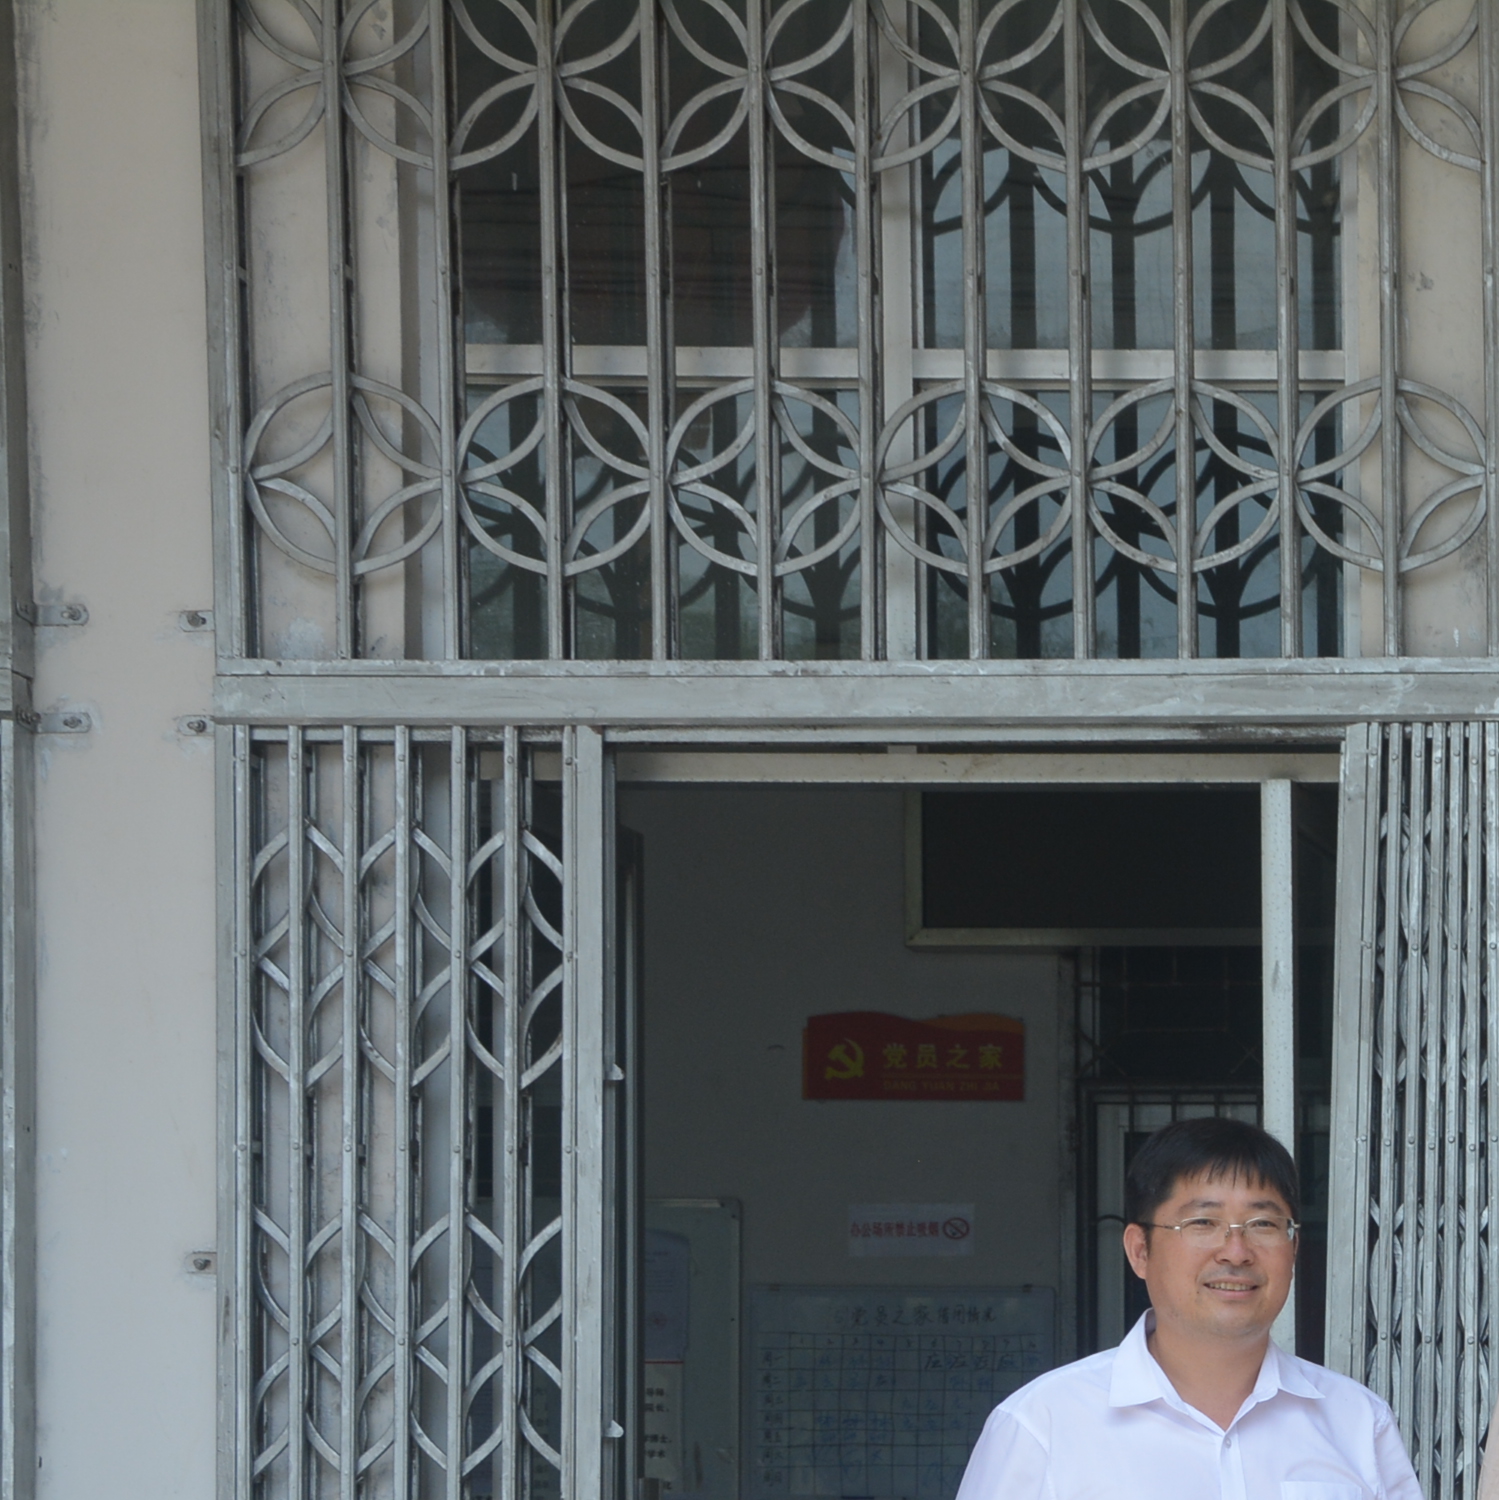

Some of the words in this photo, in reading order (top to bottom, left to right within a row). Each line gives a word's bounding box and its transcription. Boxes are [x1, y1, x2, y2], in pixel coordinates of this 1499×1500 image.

[882, 1043, 1003, 1069] 党员之家
[883, 1081, 917, 1092] DANG
